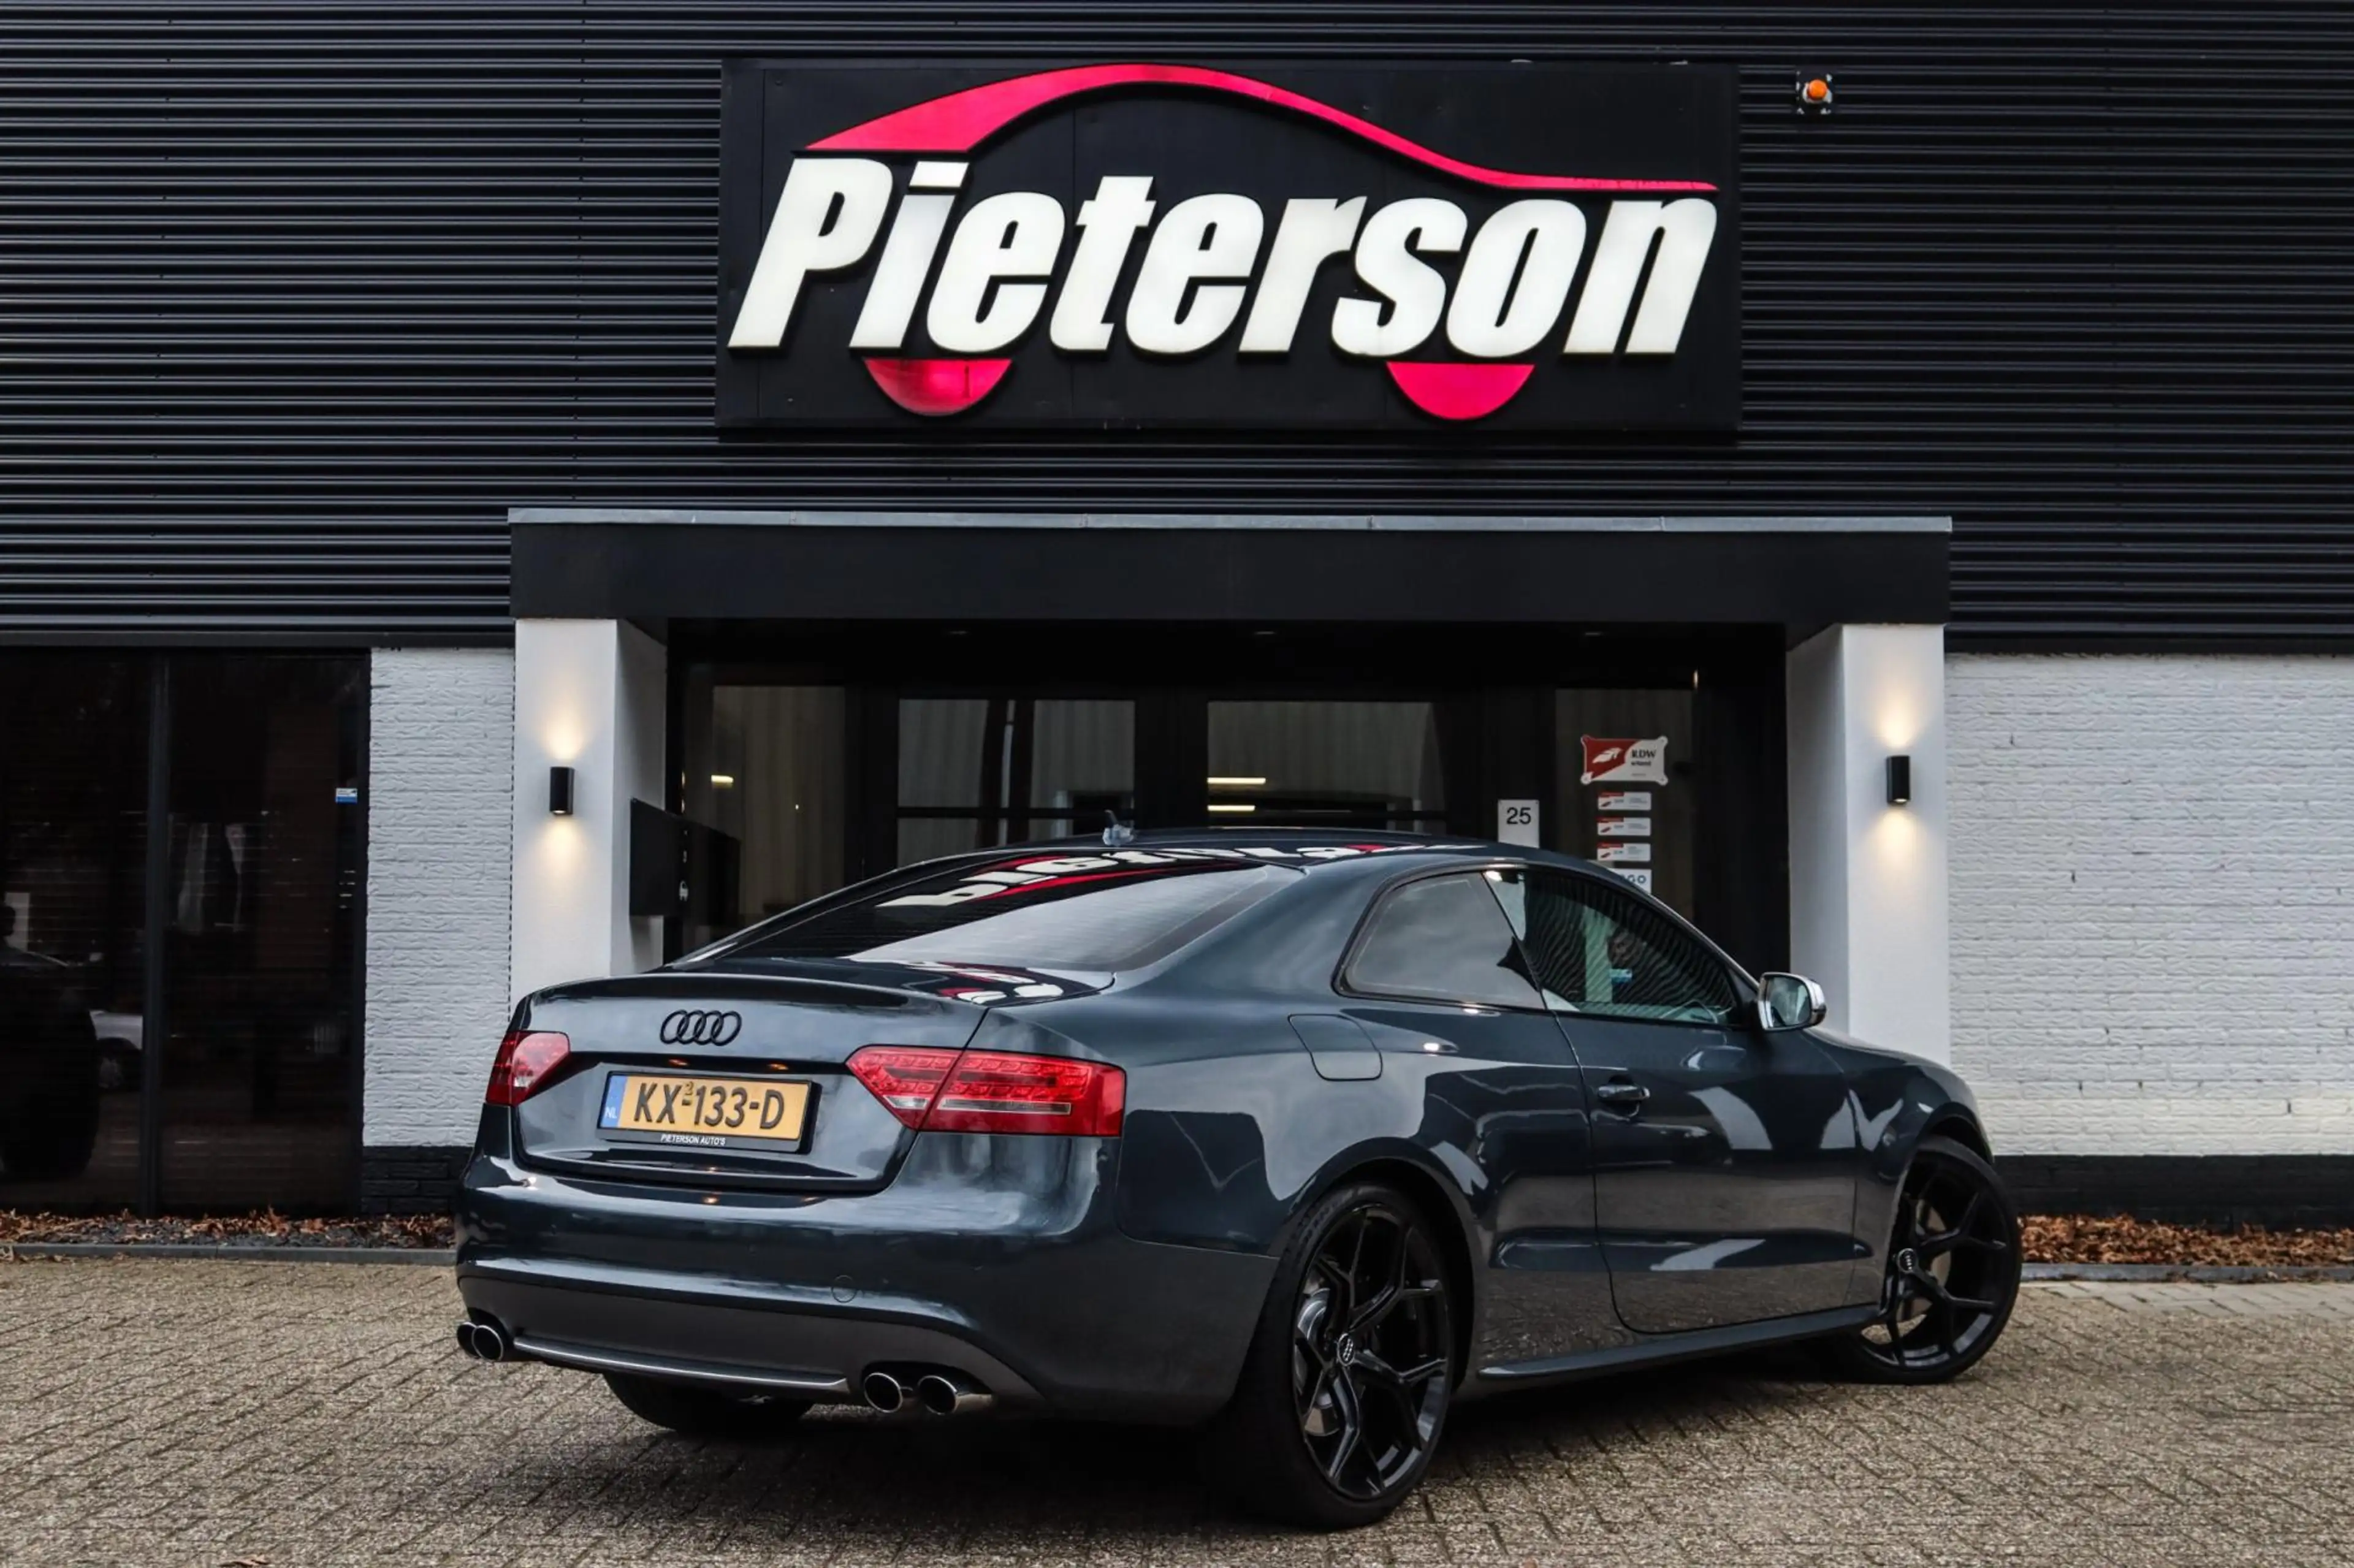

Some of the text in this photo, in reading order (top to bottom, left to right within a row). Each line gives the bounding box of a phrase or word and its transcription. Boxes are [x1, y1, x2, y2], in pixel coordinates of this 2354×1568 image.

[729, 159, 1716, 356] Pieterson
[1631, 749, 1656, 758] RDW
[1506, 807, 1531, 825] 25
[604, 1106, 617, 1119] NL
[633, 1082, 785, 1130] KX-133-D
[660, 1133, 726, 1146] PIETERSON AUTO'S
